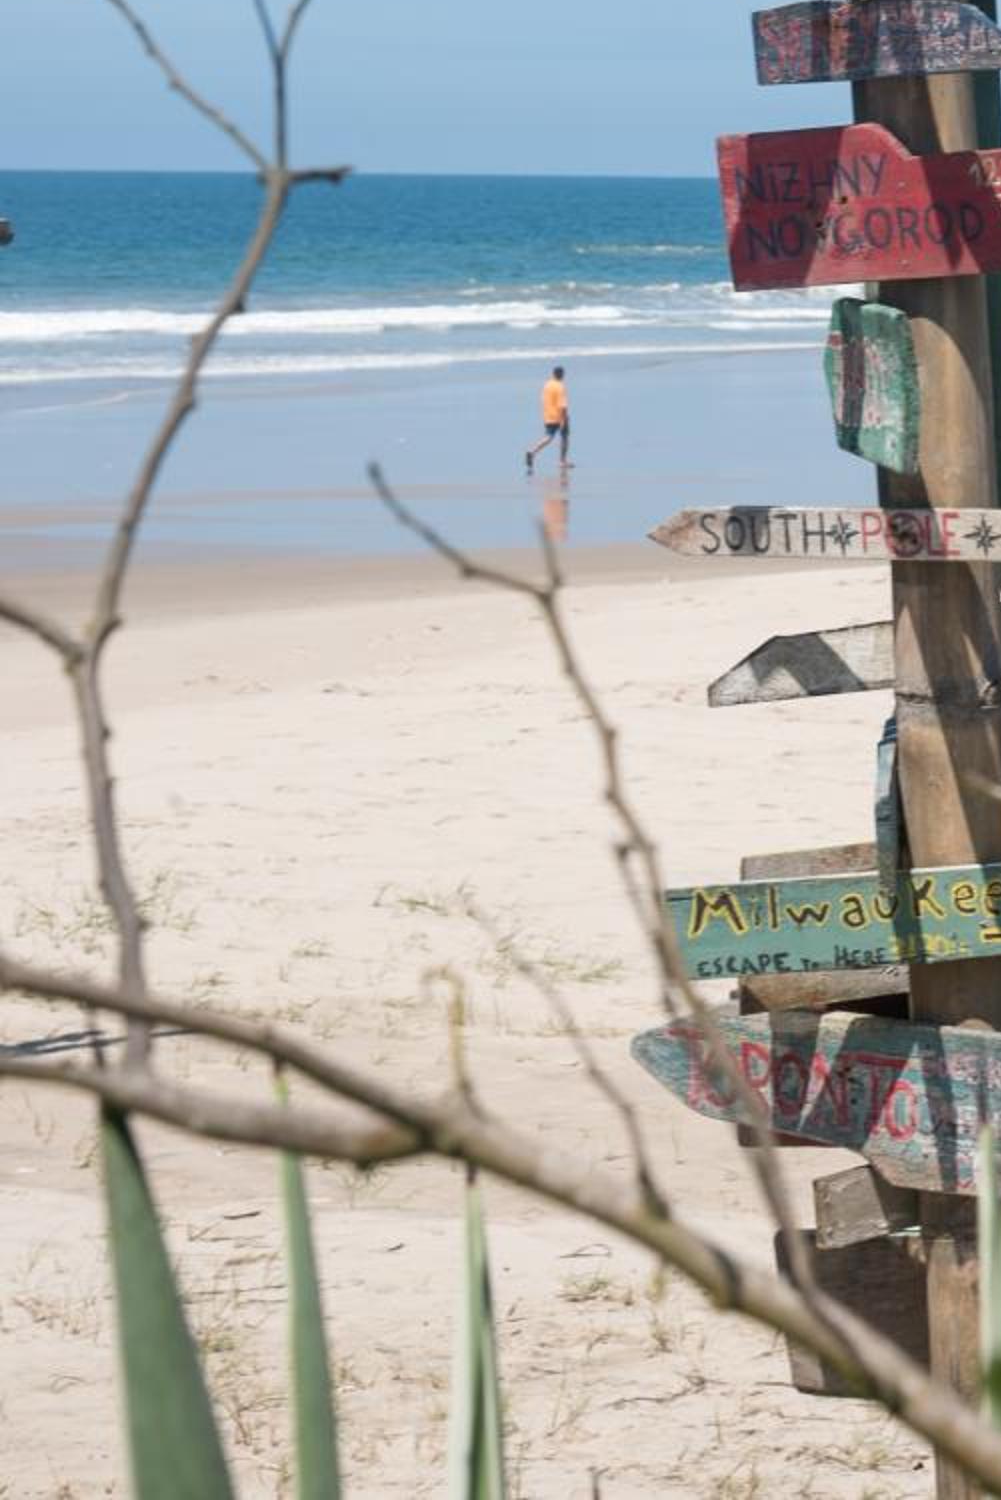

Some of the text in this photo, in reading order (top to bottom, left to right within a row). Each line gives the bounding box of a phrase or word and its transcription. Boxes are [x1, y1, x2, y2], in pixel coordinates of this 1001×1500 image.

[699, 513, 828, 554] SOUTH
[697, 951, 792, 977] ESCAPE
[834, 944, 888, 967] HERE
